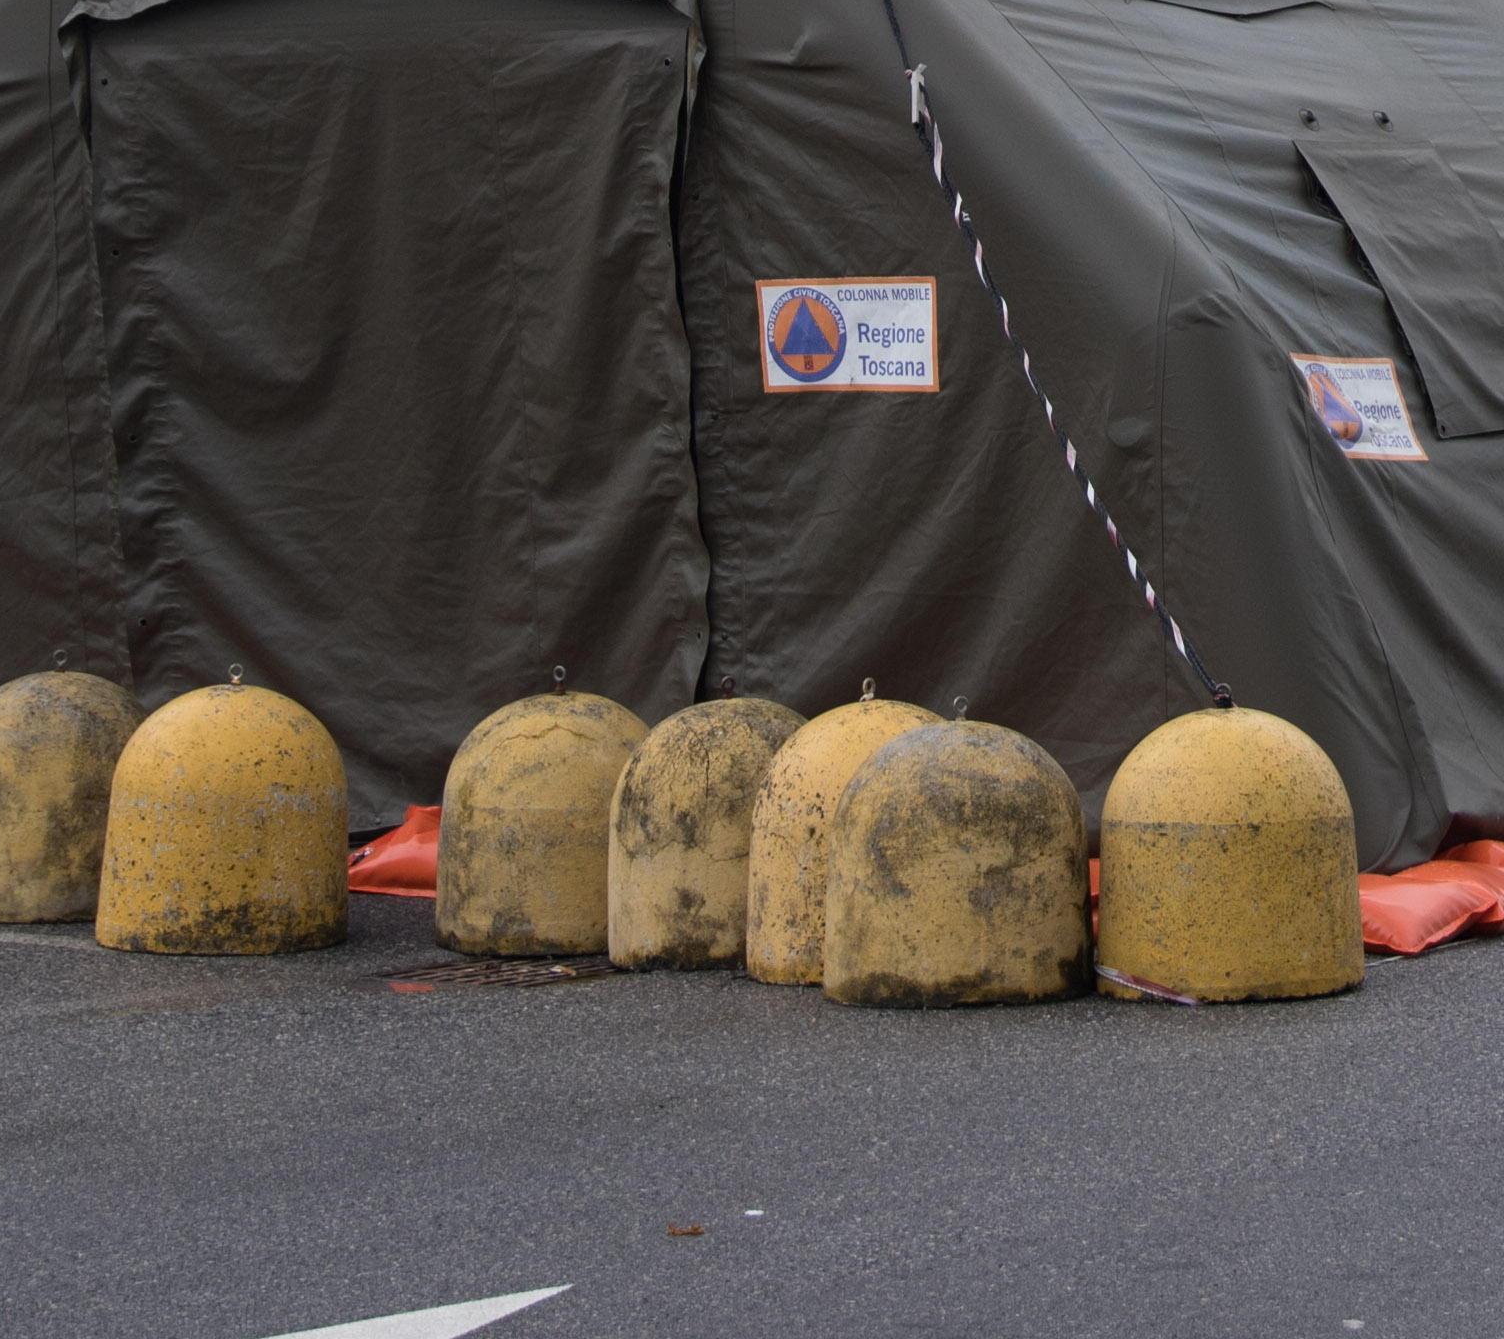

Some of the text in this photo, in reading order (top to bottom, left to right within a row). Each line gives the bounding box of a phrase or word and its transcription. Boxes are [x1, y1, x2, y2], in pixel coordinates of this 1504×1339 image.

[837, 287, 930, 302] COLONNA MOBILE
[794, 289, 817, 300] CIVILE
[818, 295, 845, 335] TOSCANA
[857, 322, 925, 348] Regione
[858, 355, 925, 377] Toscana
[1353, 399, 1402, 424] Regione
